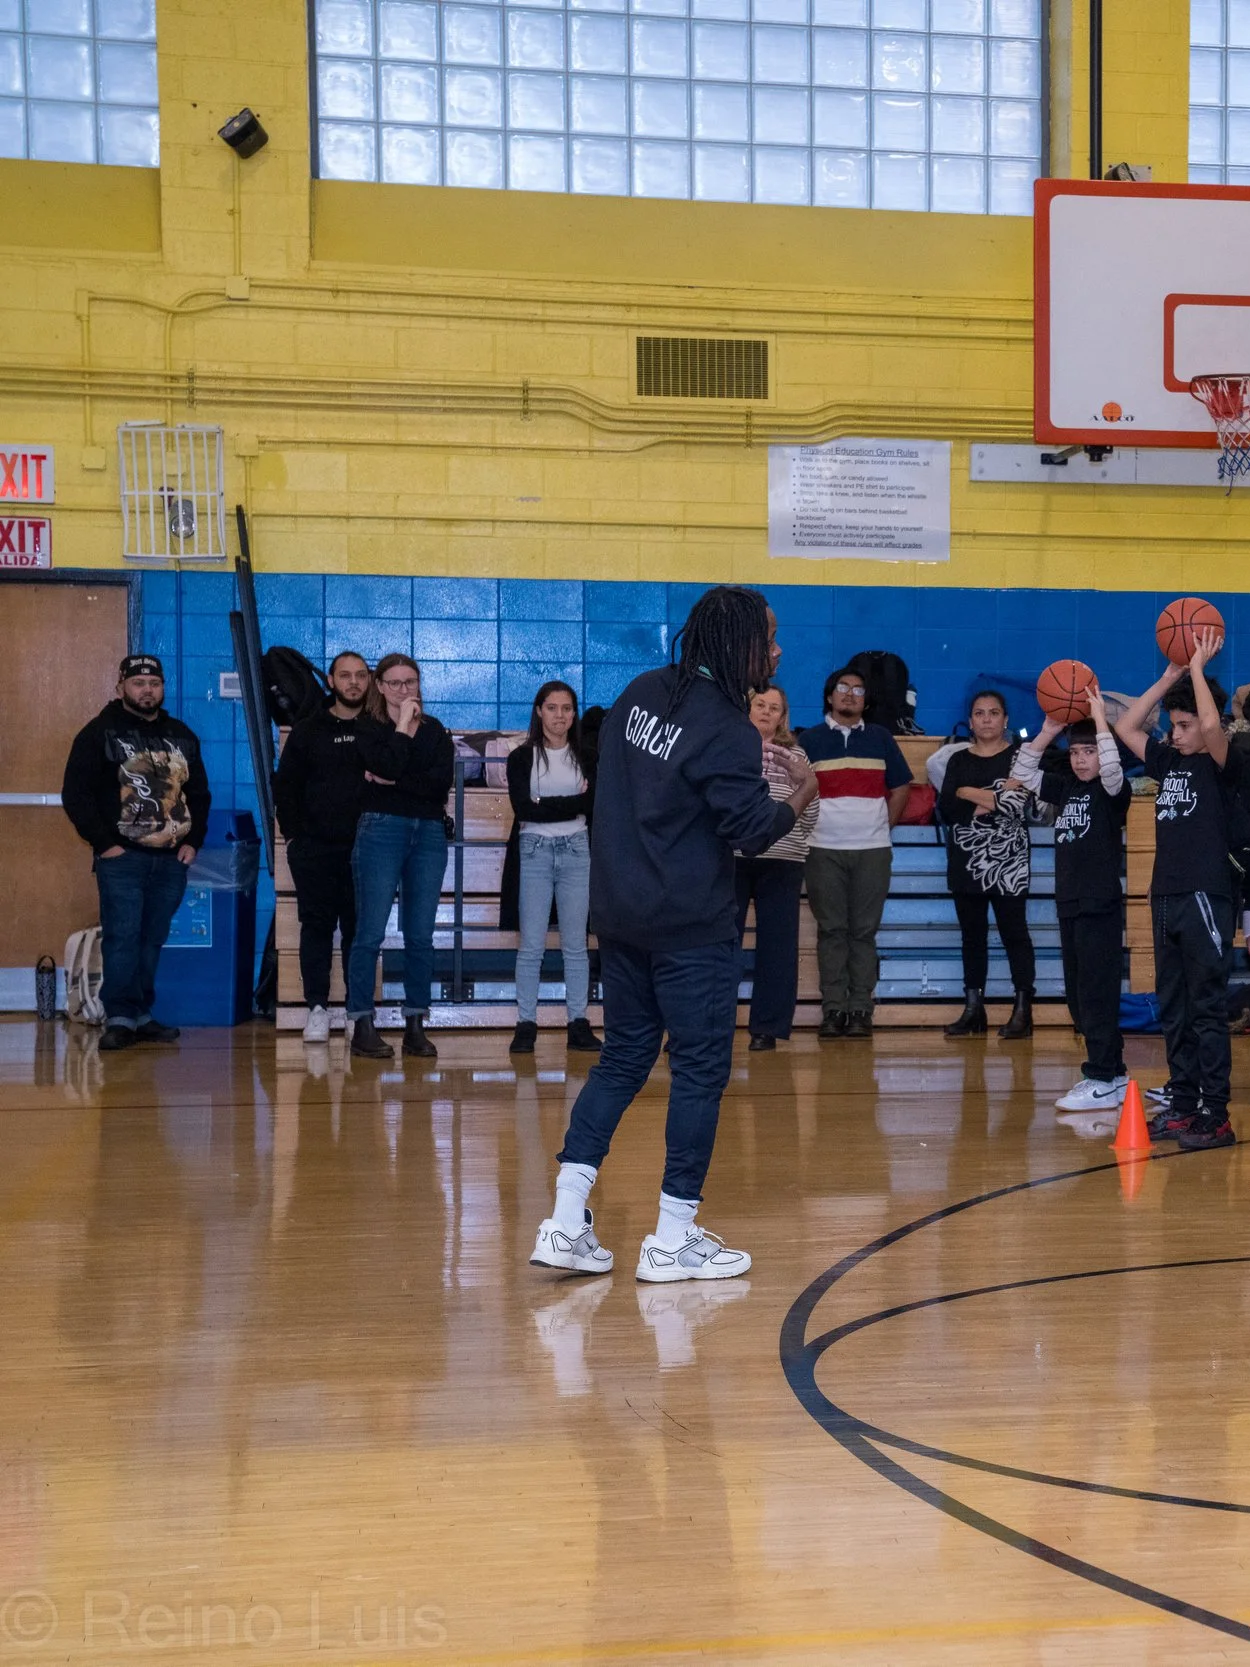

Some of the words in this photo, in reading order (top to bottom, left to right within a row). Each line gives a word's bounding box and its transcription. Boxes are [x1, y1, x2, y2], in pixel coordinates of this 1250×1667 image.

[836, 447, 874, 457] Education
[876, 448, 895, 458] Gym
[897, 449, 919, 459] Rules
[0, 452, 47, 498] XIT
[0, 520, 46, 553] XIT
[800, 522, 823, 530] Respect
[0, 555, 42, 567] ALIDA
[626, 705, 683, 761] COACH
